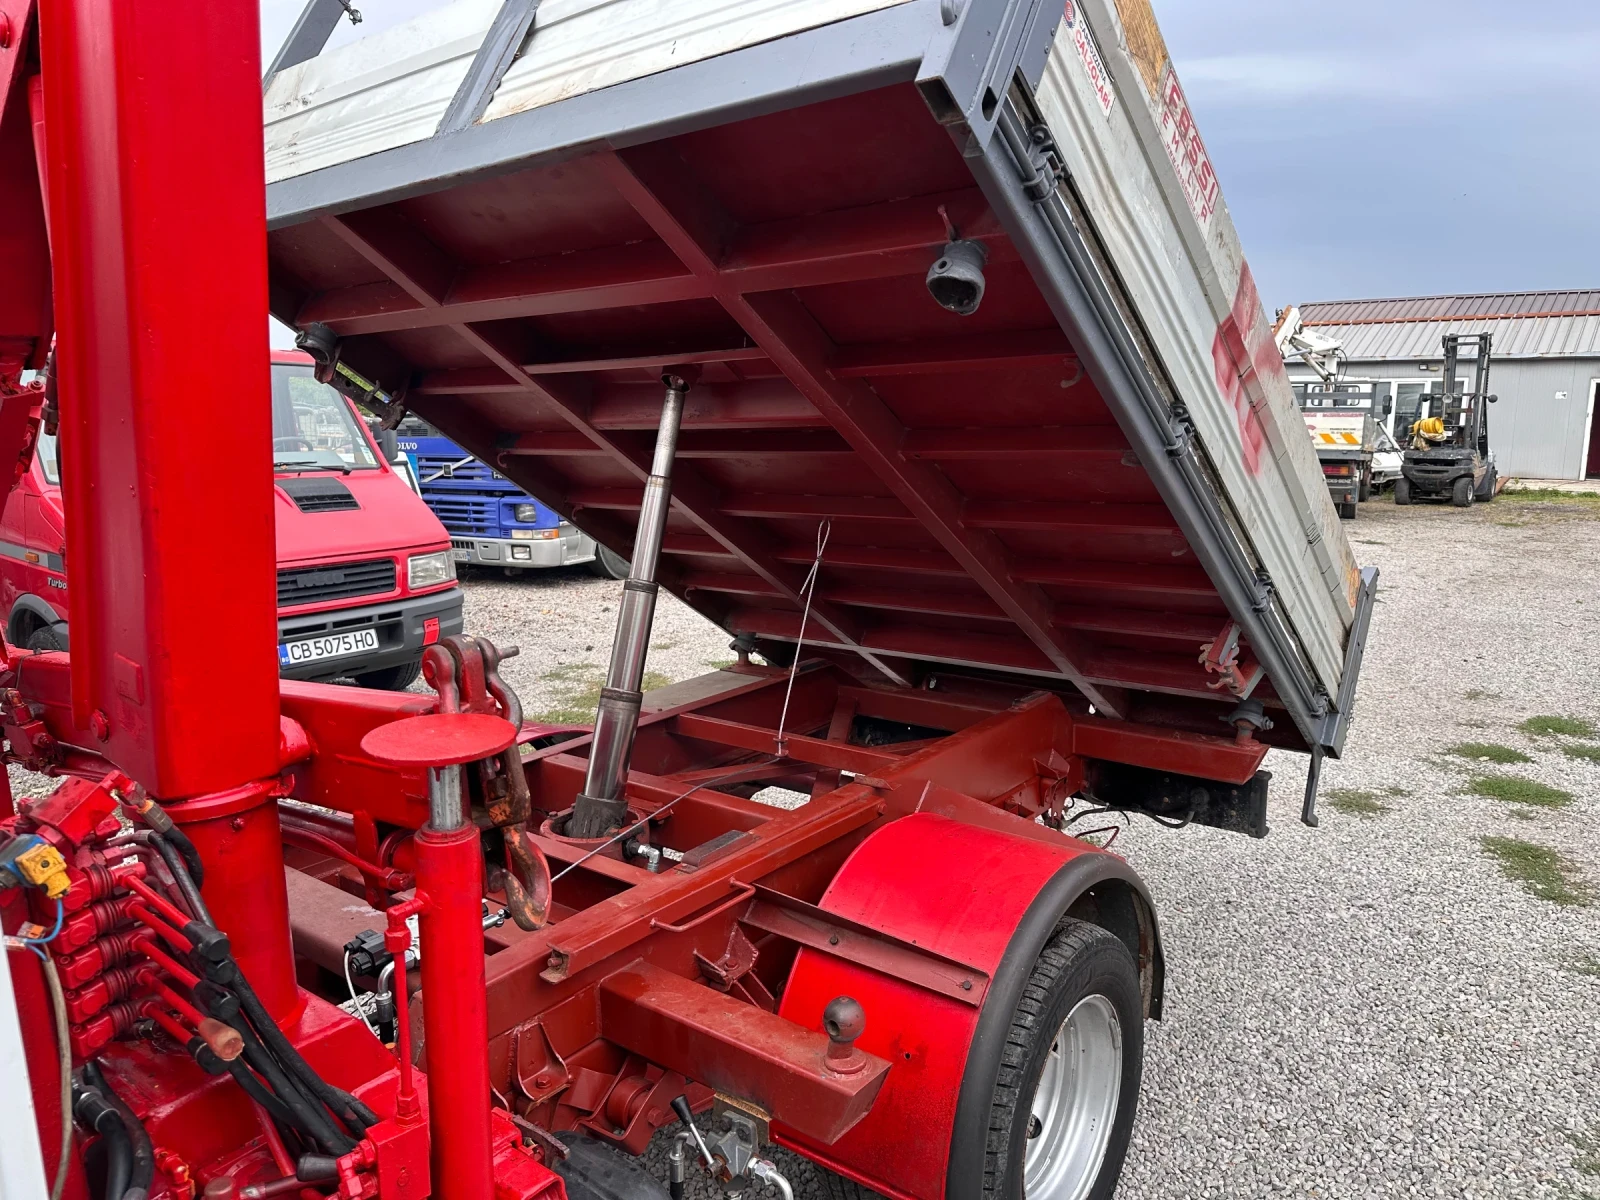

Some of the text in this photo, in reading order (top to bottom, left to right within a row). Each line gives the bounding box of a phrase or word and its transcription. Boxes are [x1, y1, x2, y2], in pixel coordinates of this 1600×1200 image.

[1075, 29, 1111, 110] CALZOLARI
[1079, 19, 1106, 85] CARROZZERIA
[1162, 111, 1208, 224] EMILIA
[1168, 84, 1217, 203] FASSI
[397, 442, 418, 450] OLVO
[47, 576, 67, 589] Turbo
[290, 643, 312, 660] CB
[313, 635, 352, 656] 5075
